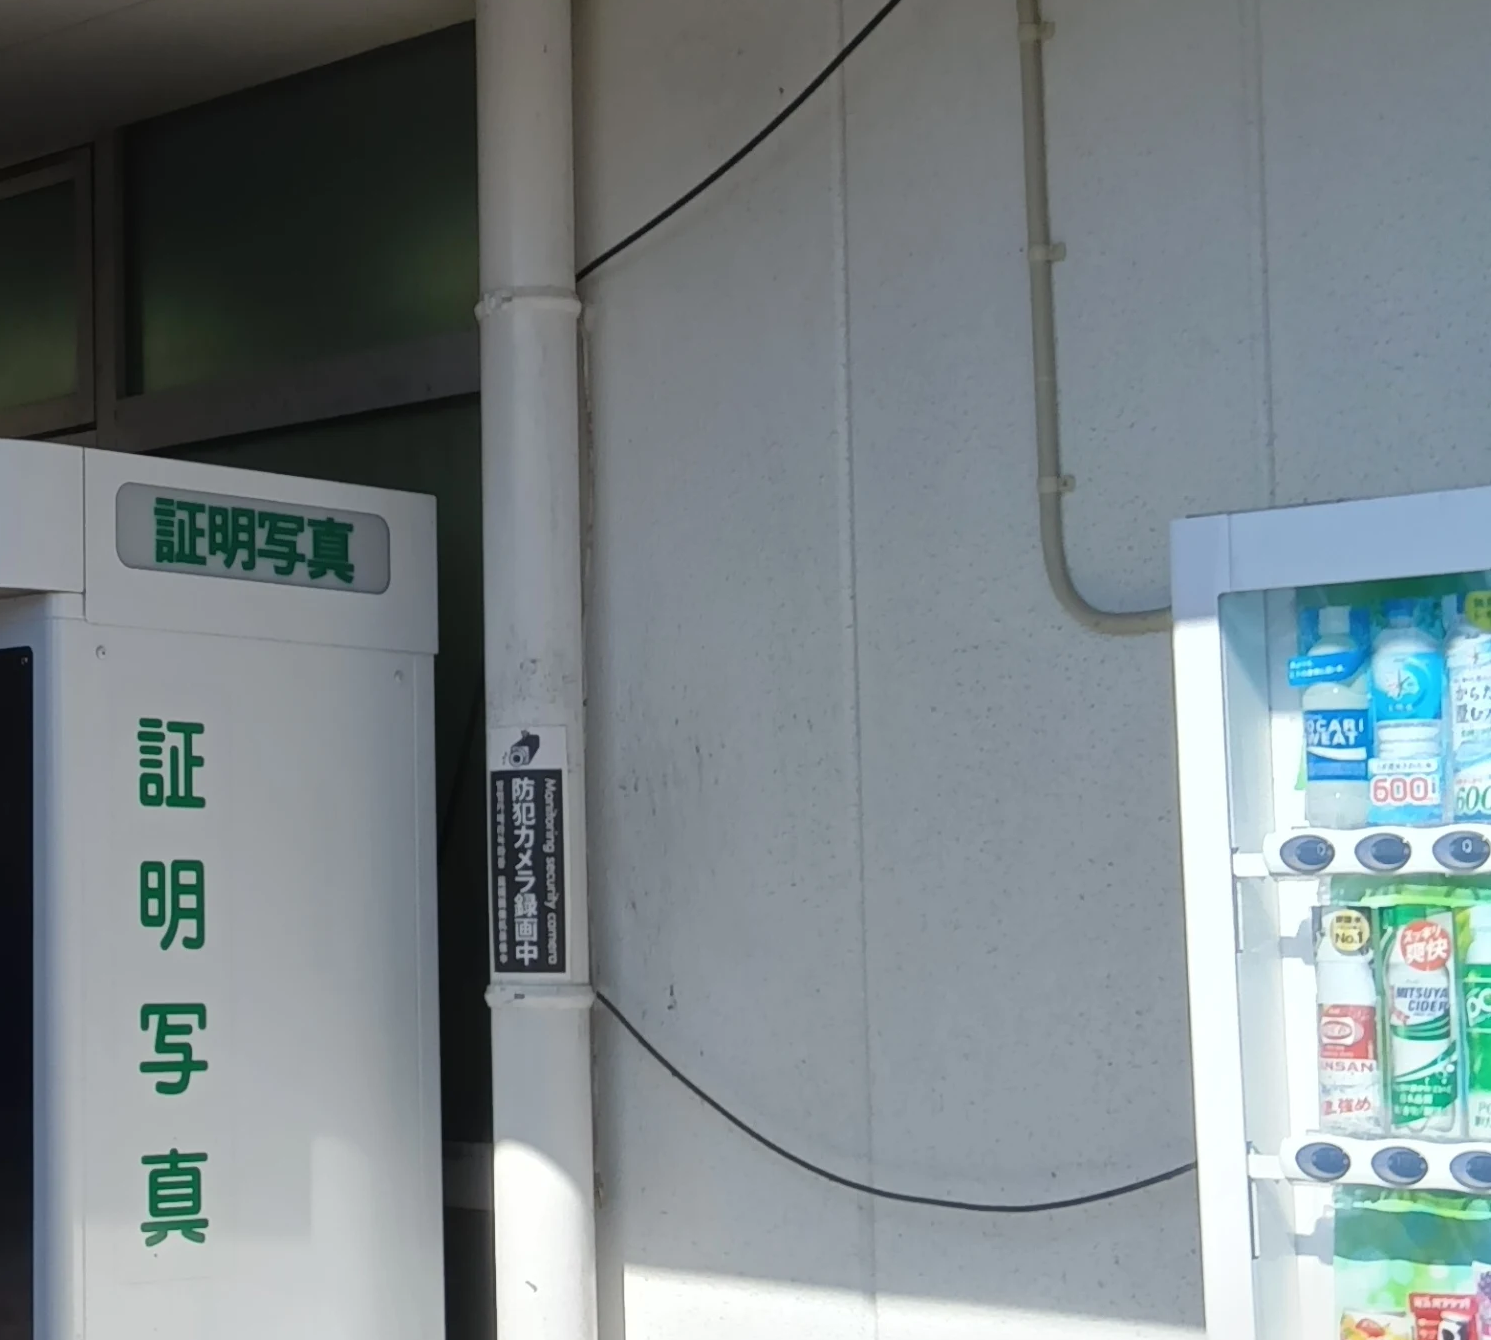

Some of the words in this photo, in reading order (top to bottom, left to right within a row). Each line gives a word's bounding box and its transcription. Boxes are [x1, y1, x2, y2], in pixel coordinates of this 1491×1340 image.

[154, 497, 355, 584] 証明写真
[542, 777, 558, 853] Monitoring
[1373, 776, 1429, 803] 600
[512, 776, 539, 966] 防犯カメラ録画中
[543, 856, 559, 910] security
[547, 912, 558, 965] camera
[1334, 930, 1365, 945] No.1
[1406, 939, 1449, 961] 爽快
[137, 717, 209, 1247] 証明写真
[1395, 986, 1450, 1000] MITSUYA
[1408, 999, 1450, 1012] CIDER
